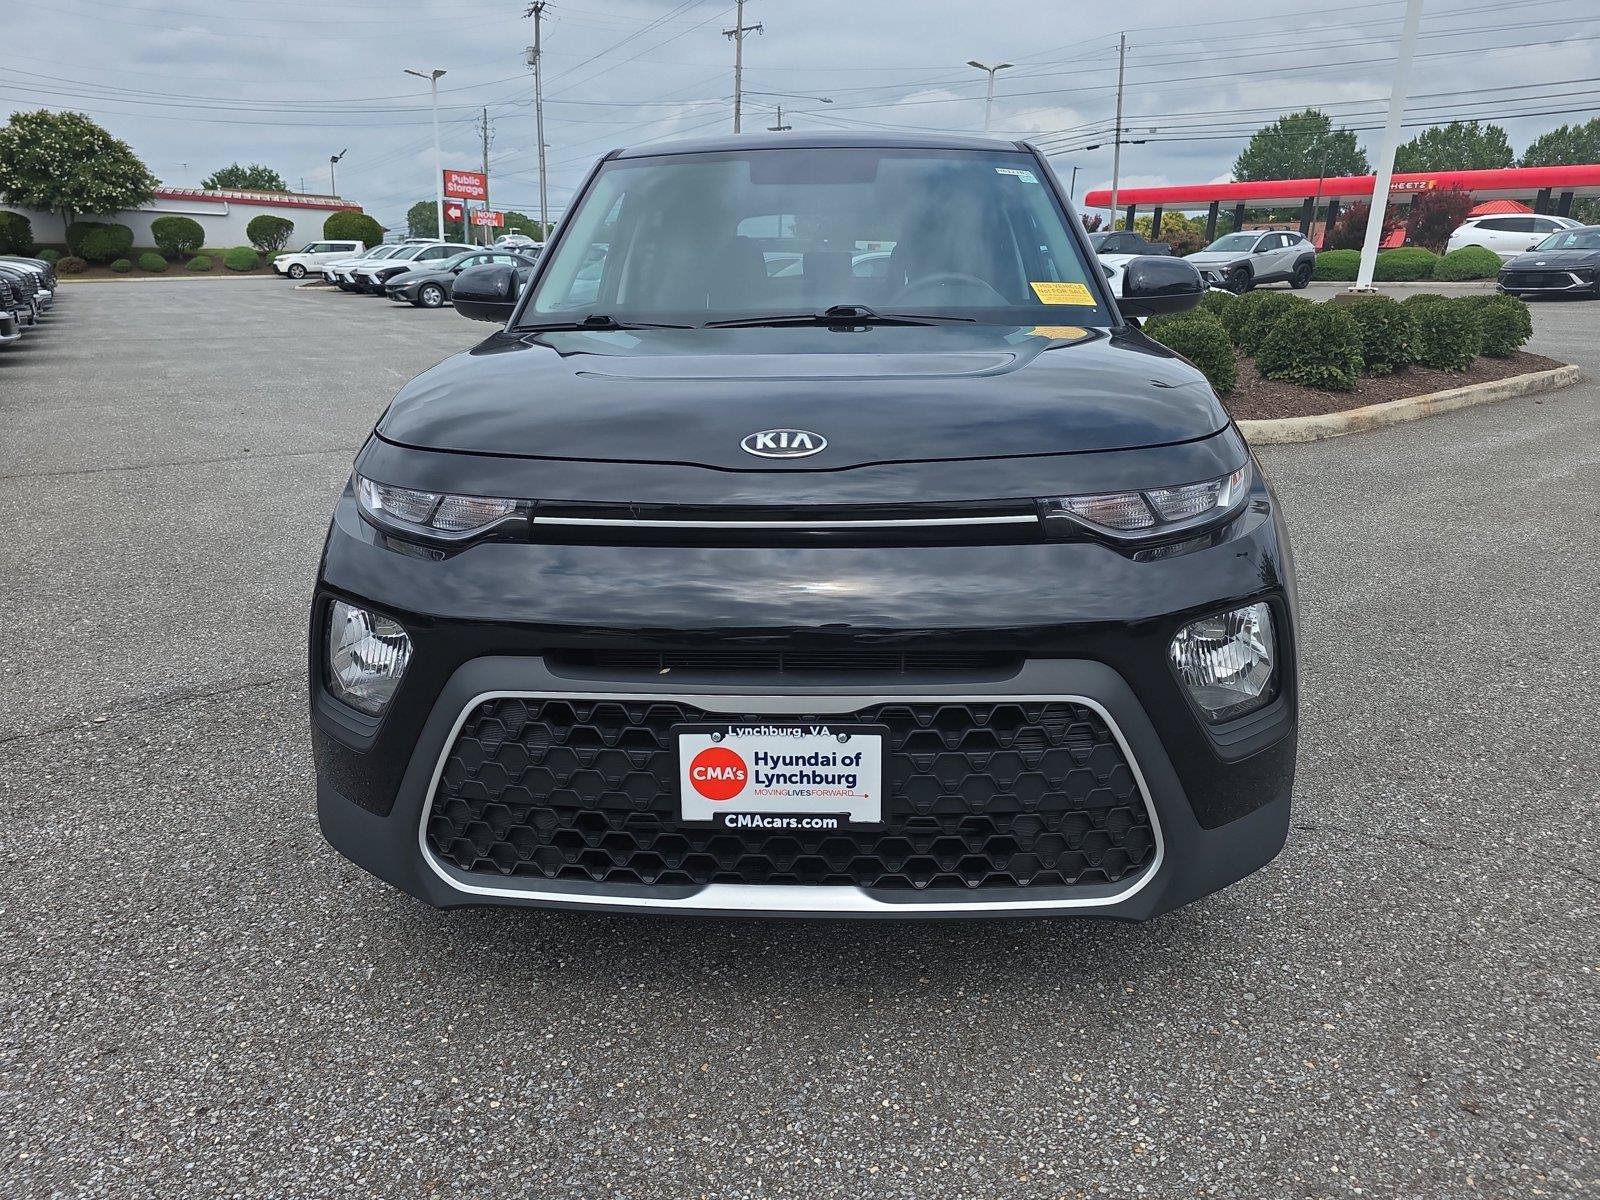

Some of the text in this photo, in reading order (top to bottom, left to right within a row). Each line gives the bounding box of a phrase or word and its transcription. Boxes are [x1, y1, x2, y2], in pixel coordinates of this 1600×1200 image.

[451, 174, 480, 186] Public
[1390, 181, 1427, 189] HEETZ
[447, 181, 484, 196] Storage
[476, 218, 498, 227] OPEN
[477, 211, 497, 219] NOW
[755, 432, 814, 450] KIA
[728, 725, 831, 739] Lynchburg, VA
[754, 751, 862, 770] Hyundai of
[692, 766, 745, 781] CMA's
[754, 769, 858, 789] Lynchburg
[724, 814, 838, 829] CMAcars.com
